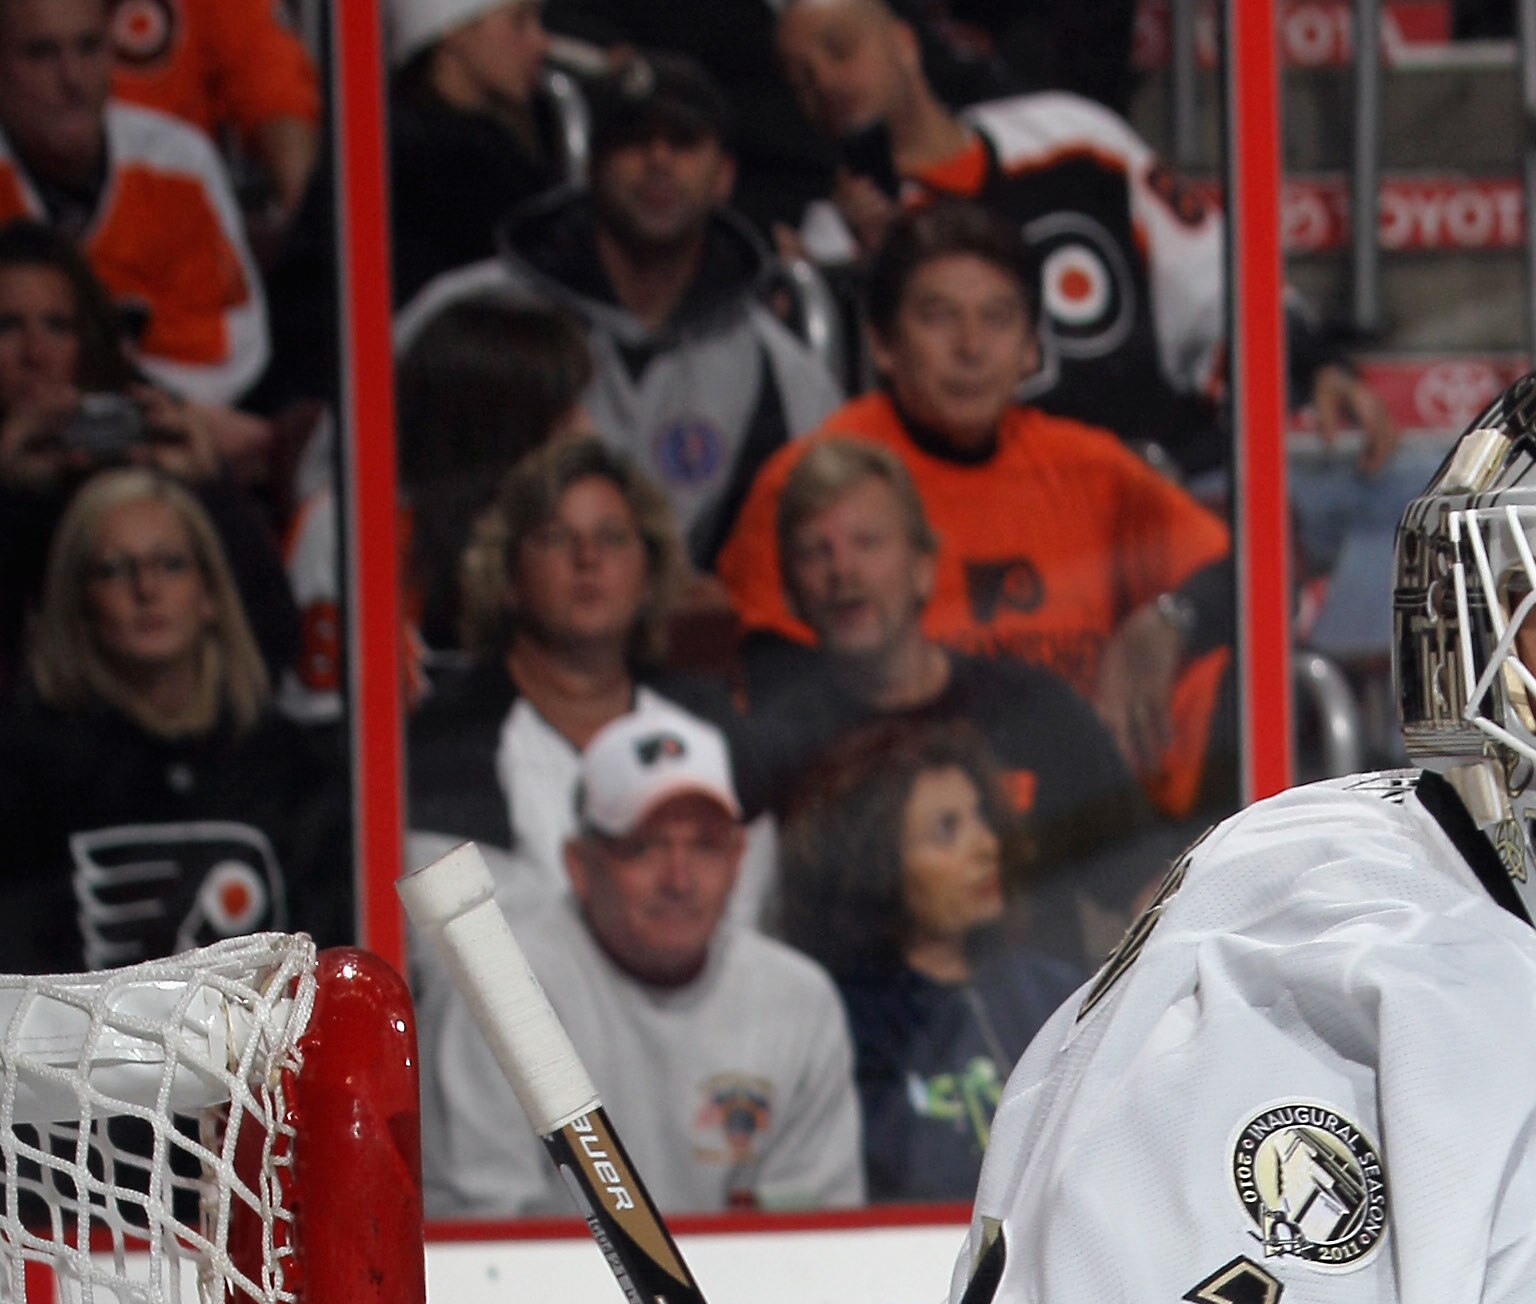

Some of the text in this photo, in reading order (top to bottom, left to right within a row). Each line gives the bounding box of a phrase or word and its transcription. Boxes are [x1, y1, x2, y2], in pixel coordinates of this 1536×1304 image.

[1236, 1151, 1259, 1204] 2010
[1248, 1106, 1386, 1238] INAUGURAL SEASON
[1318, 1242, 1362, 1261] 2011
